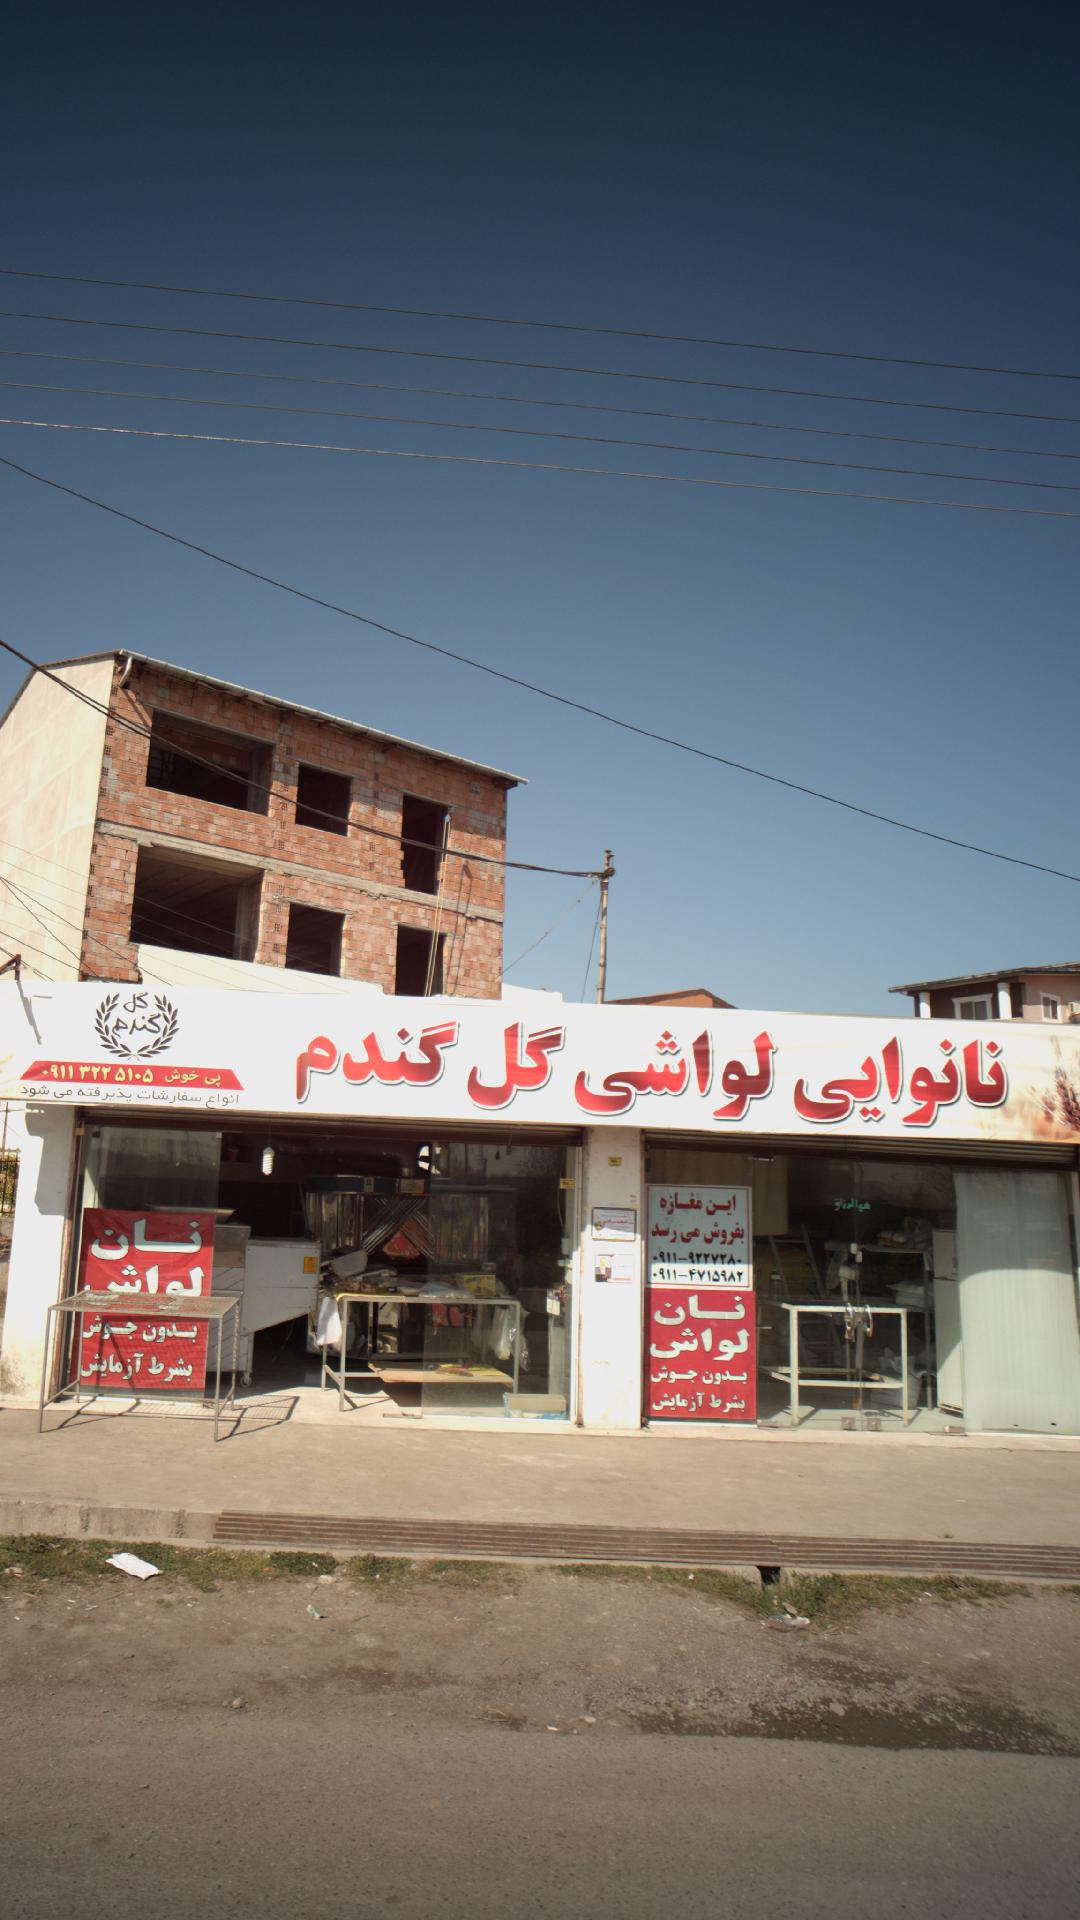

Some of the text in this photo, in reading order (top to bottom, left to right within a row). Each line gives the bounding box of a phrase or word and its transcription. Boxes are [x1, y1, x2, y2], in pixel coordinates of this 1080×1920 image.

[123, 991, 148, 1013] گل
[112, 1013, 161, 1038] گندم
[42, 1064, 73, 1080] ۰۹۱۱
[115, 1067, 153, 1083] ۵۱۰۵
[164, 1068, 199, 1083] خوش
[296, 1020, 1007, 1126] نانوایی لواشی گل گندم
[20, 1083, 49, 1098] شود
[54, 1087, 72, 1098] می
[137, 1089, 201, 1104] سفارشات
[206, 1094, 239, 1109] انواع
[659, 1192, 736, 1216] این مغازه
[91, 1218, 203, 1260] نان
[651, 1222, 744, 1245] بفروش می رسد
[654, 1294, 746, 1325] نان
[82, 1315, 198, 1343] بدون جوش
[650, 1328, 750, 1361] لواش
[80, 1353, 193, 1382] بشرط آزمایش
[650, 1365, 747, 1384] بدون جوش
[652, 1392, 746, 1412] بشرط آزمایش
